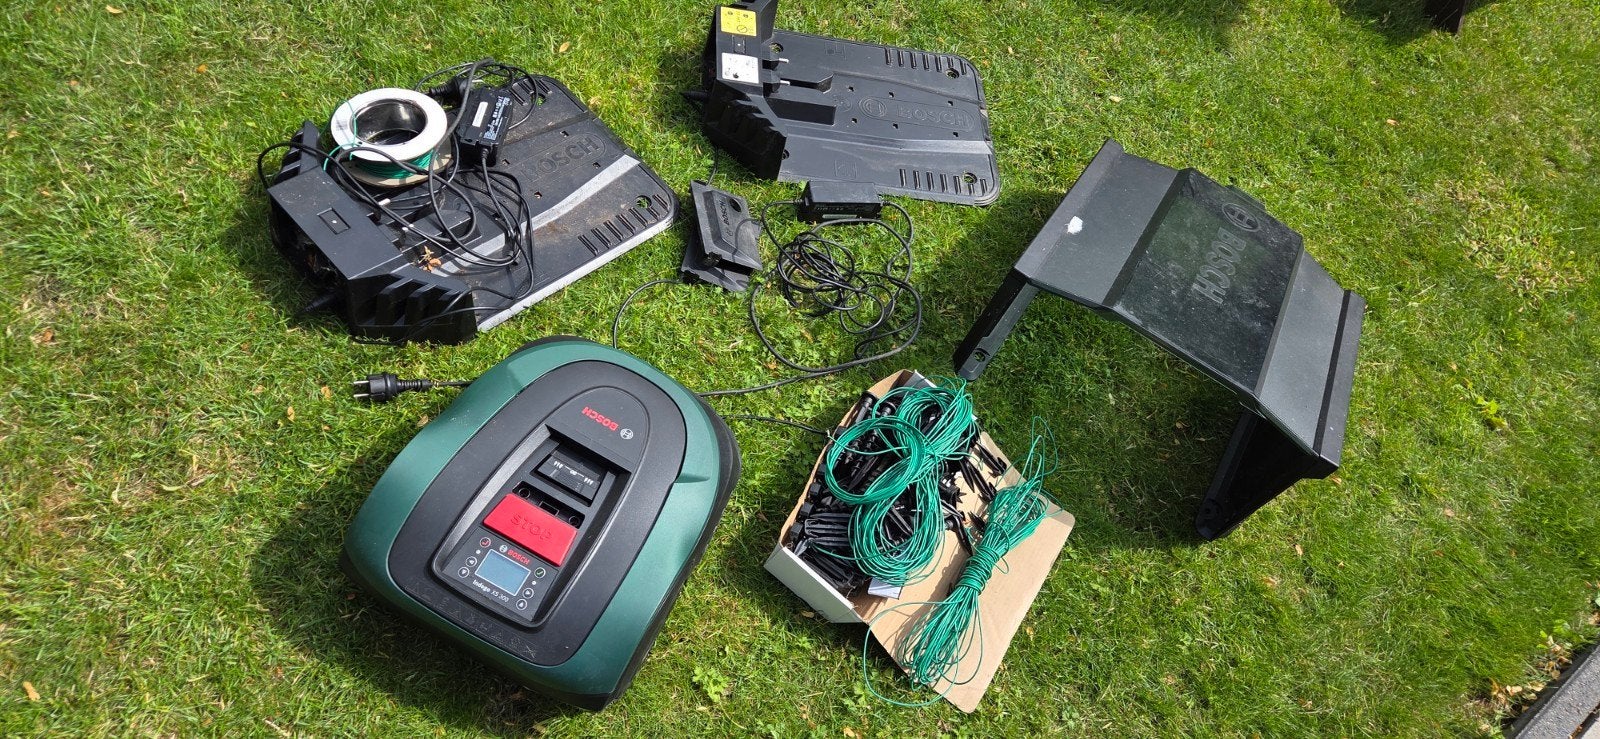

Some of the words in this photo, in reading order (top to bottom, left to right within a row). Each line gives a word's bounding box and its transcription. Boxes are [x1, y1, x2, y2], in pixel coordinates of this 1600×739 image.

[520, 136, 600, 182] BOSCH
[719, 200, 730, 226] BOSCH
[1191, 227, 1246, 303] BOSCH
[581, 406, 619, 431] BOSCH
[510, 512, 552, 540] STOP
[507, 549, 530, 565] BOSCH
[472, 579, 491, 593] Indego
